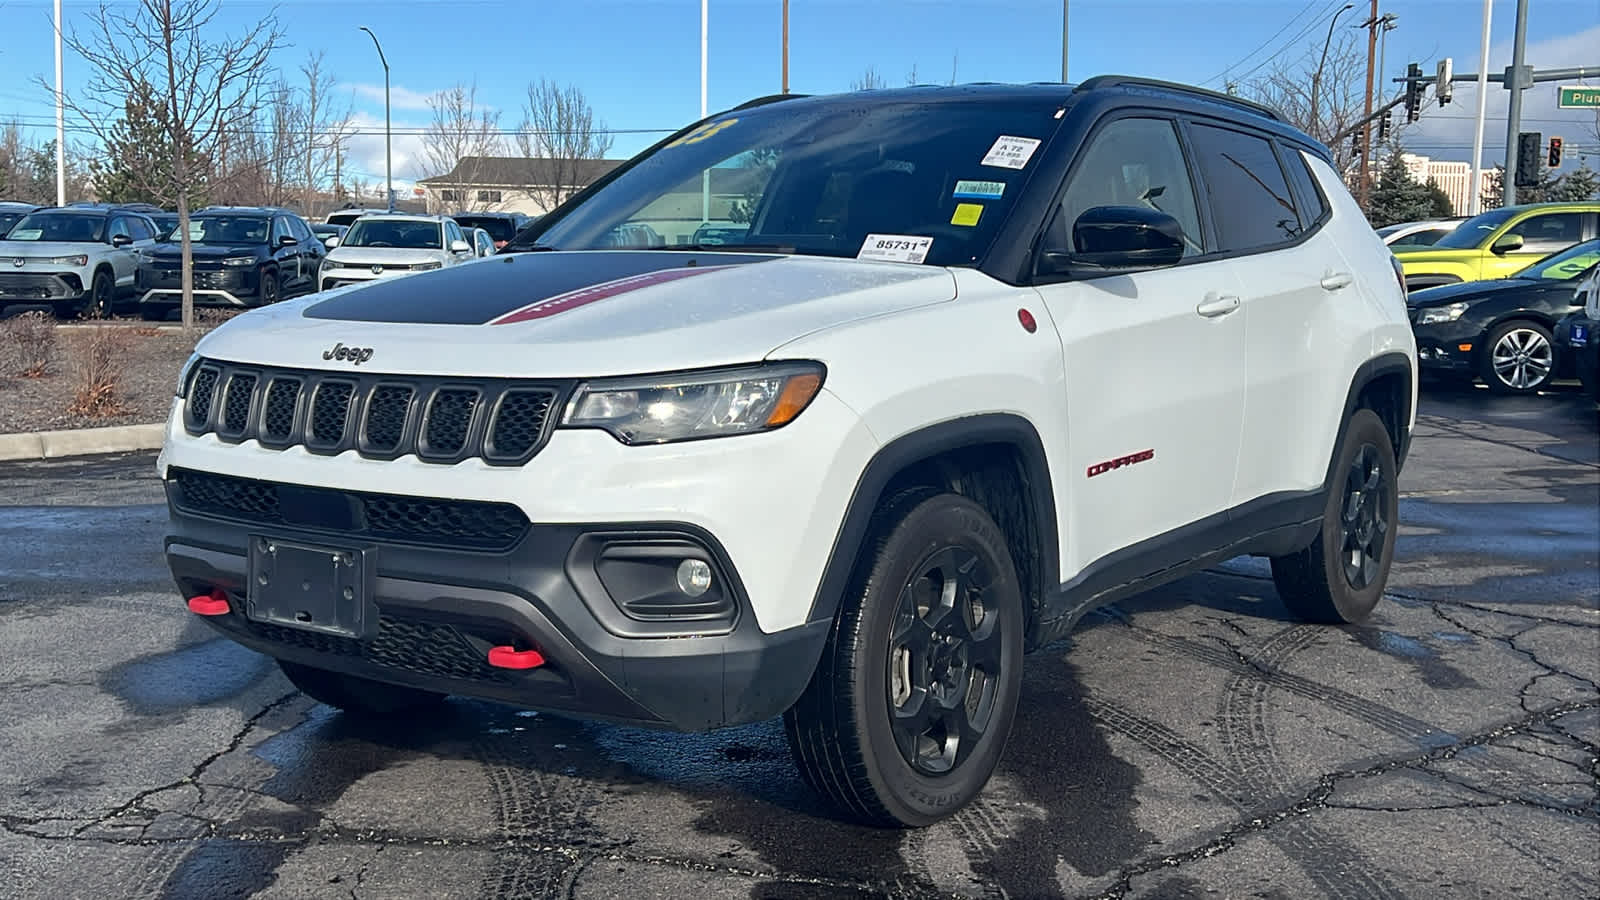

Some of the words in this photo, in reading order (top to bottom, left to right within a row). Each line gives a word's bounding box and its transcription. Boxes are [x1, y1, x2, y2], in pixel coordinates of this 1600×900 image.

[876, 239, 918, 251] 85731
[322, 342, 374, 366] Jeep
[1087, 448, 1155, 478] COMPASS
